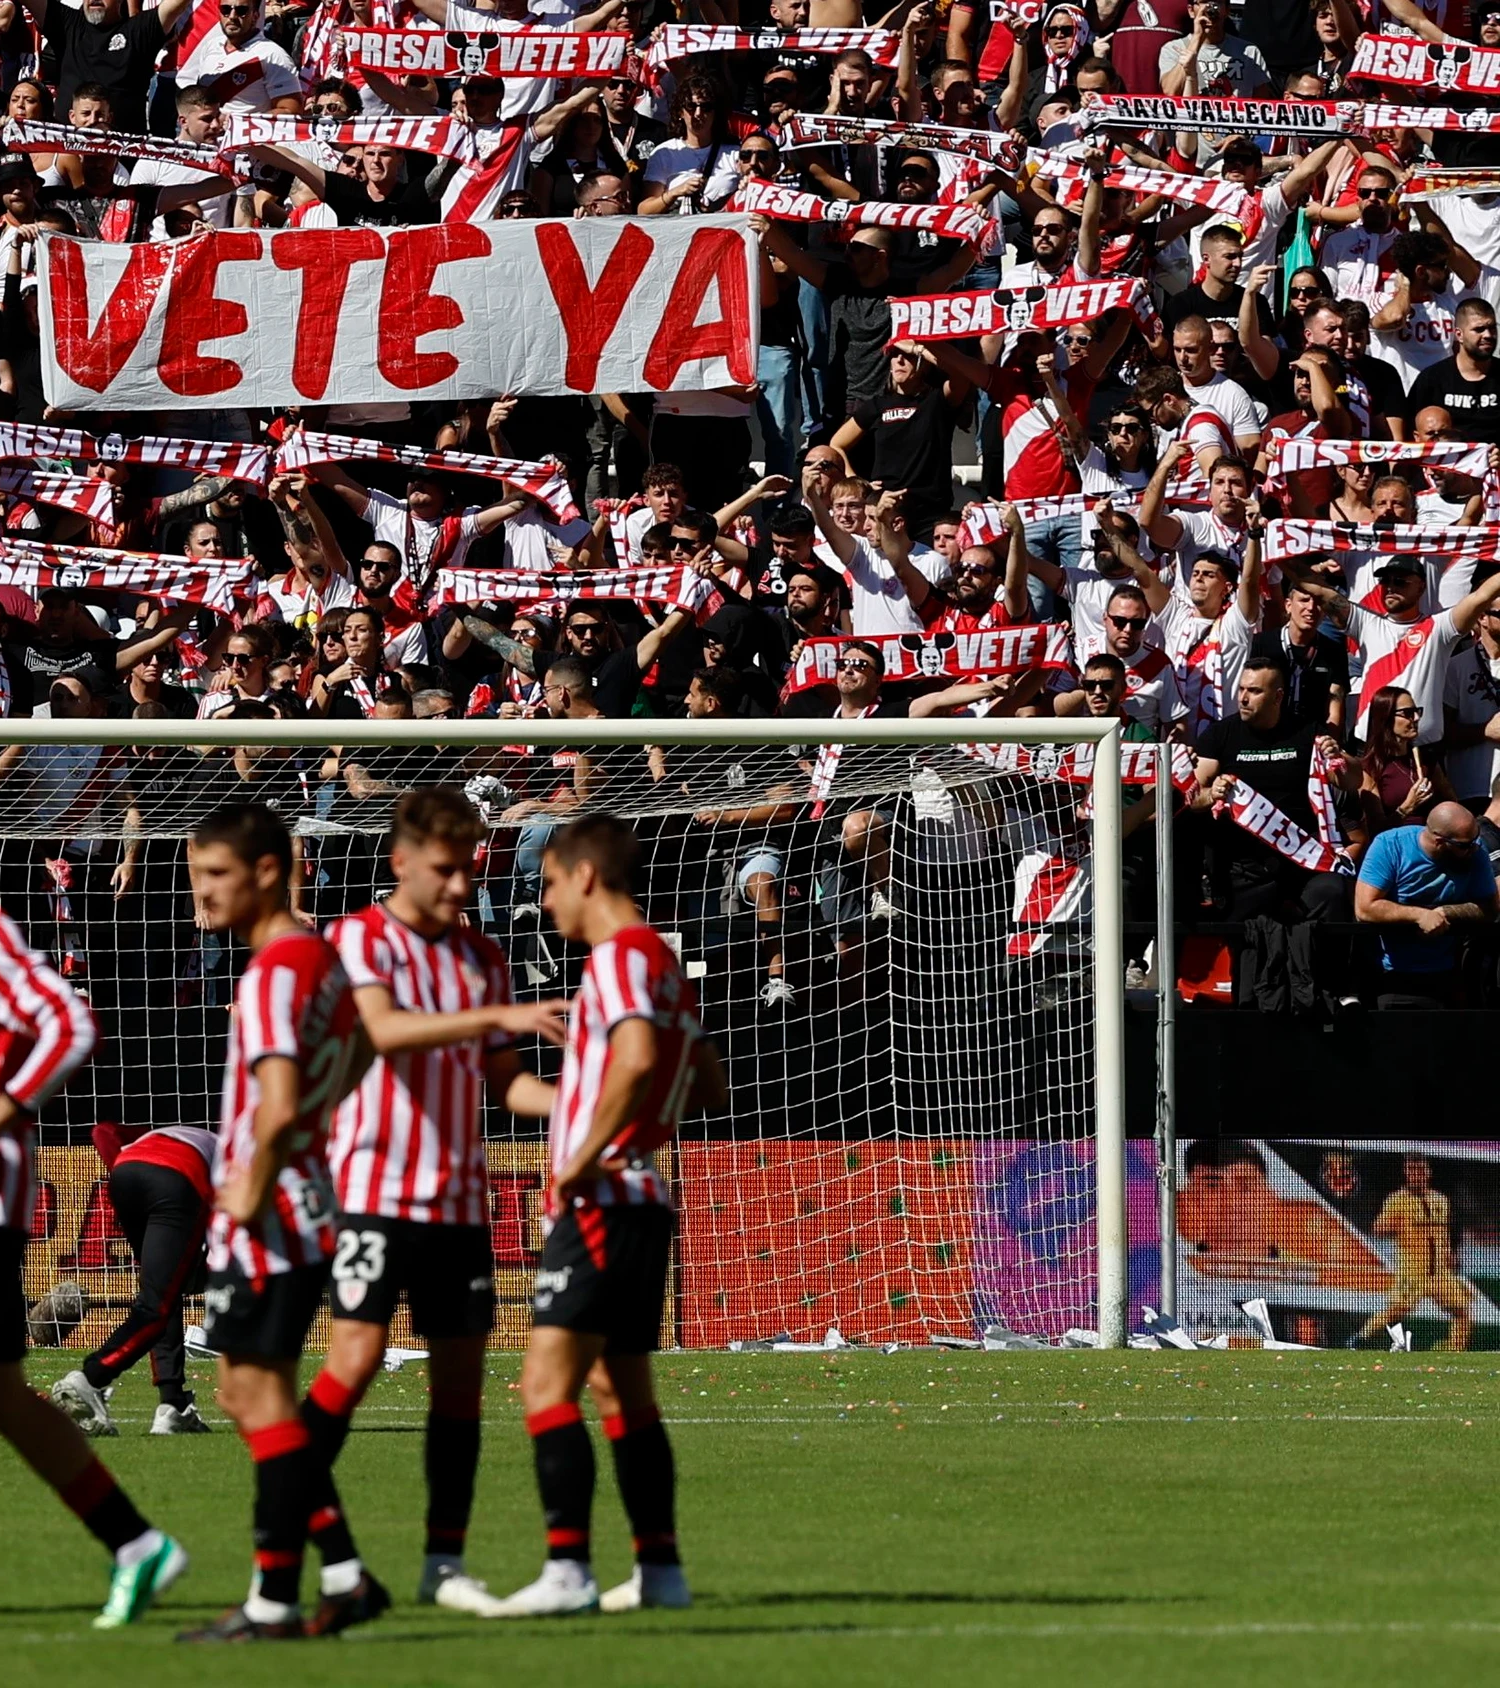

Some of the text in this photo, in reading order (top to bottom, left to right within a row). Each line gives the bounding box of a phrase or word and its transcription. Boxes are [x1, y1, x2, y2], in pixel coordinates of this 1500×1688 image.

[346, 32, 626, 71] PRESA VETE YA
[798, 27, 891, 61] VETE
[1112, 97, 1327, 127] RAYO VALLECANO
[352, 115, 442, 149] VETE
[1119, 165, 1201, 200] VETE
[861, 202, 941, 228] VETE
[47, 222, 757, 400] VETE YA
[891, 280, 1129, 339] PRESA VETE
[1444, 393, 1498, 408] BVK 92
[140, 436, 233, 473] VETE
[1395, 524, 1489, 554] VETE
[438, 568, 541, 604] PRESA
[591, 566, 676, 600] VETE
[796, 639, 903, 686] PRA
[957, 627, 1040, 670] VETE
[1073, 743, 1157, 778] VTE
[1232, 778, 1325, 868] PRESA
[332, 1230, 387, 1282] 23
